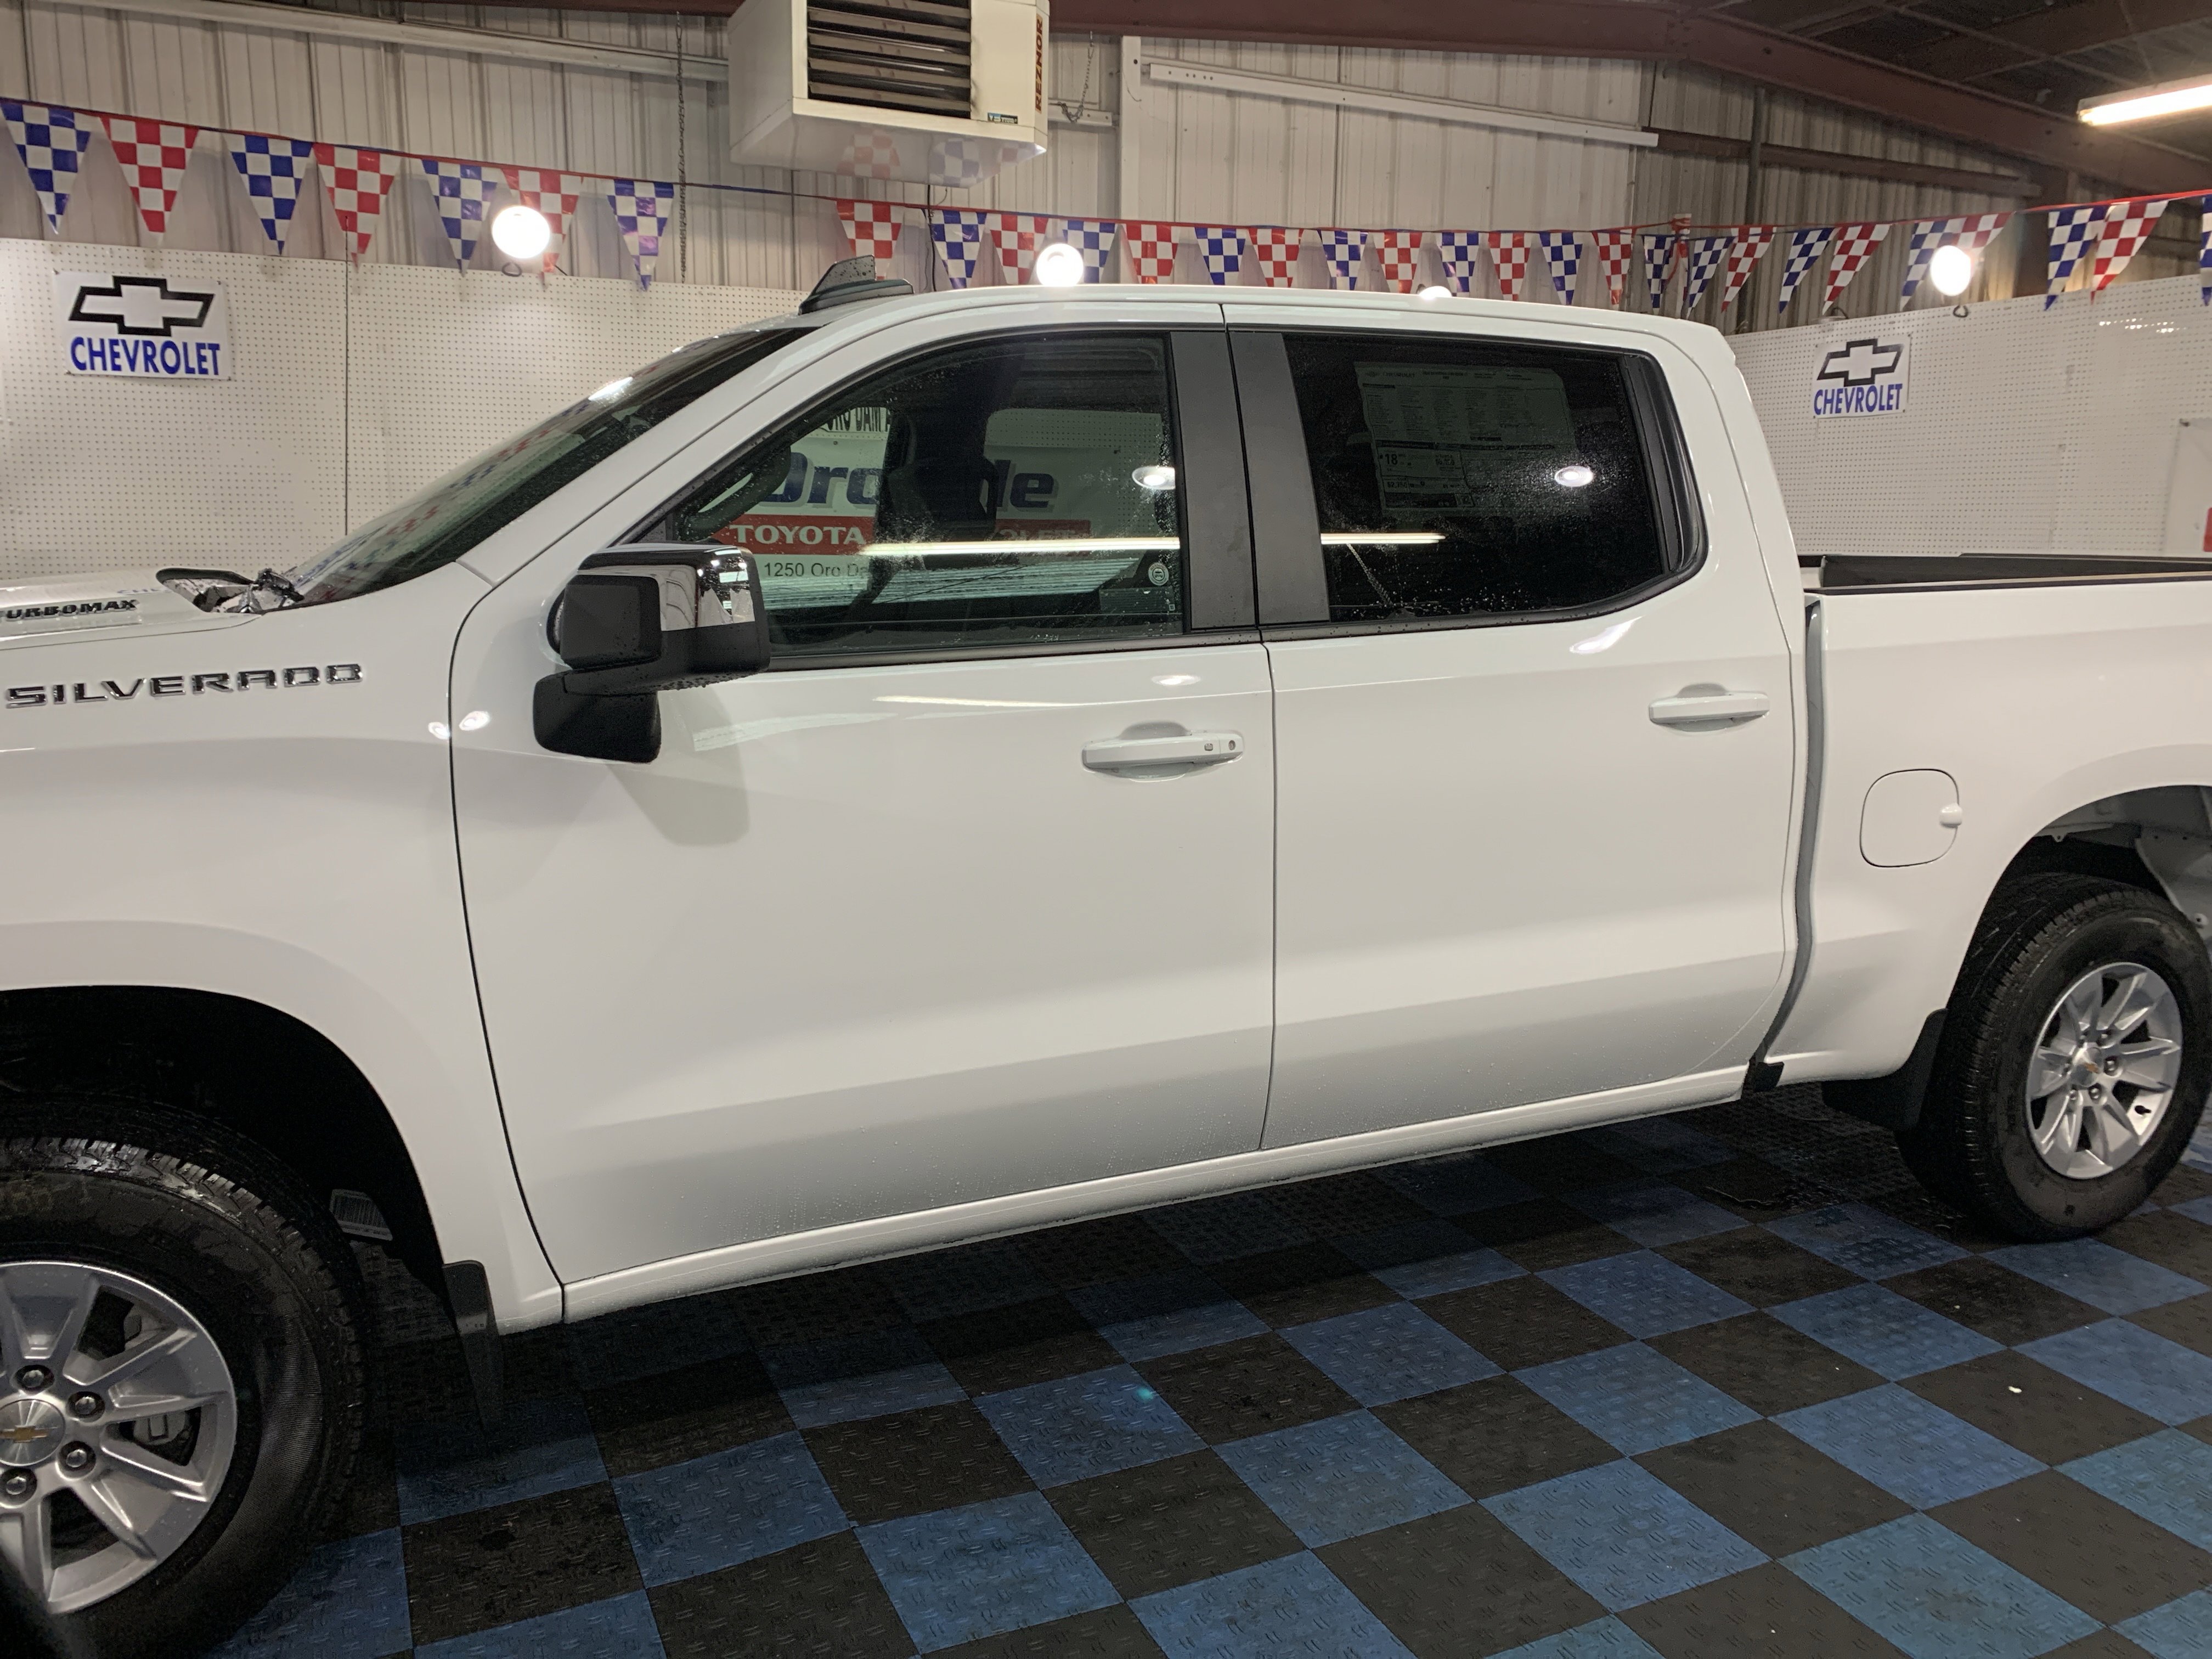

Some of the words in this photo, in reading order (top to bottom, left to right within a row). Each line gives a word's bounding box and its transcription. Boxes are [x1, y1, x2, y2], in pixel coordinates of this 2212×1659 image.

[71, 336, 221, 376] CHEVROLET
[1814, 383, 1903, 415] CHEVROLET
[1385, 454, 1398, 465] 18
[729, 524, 866, 545] TOYOTA
[764, 562, 805, 577] 1250
[811, 562, 840, 577] Oro
[6, 663, 363, 708] SILVERADO
